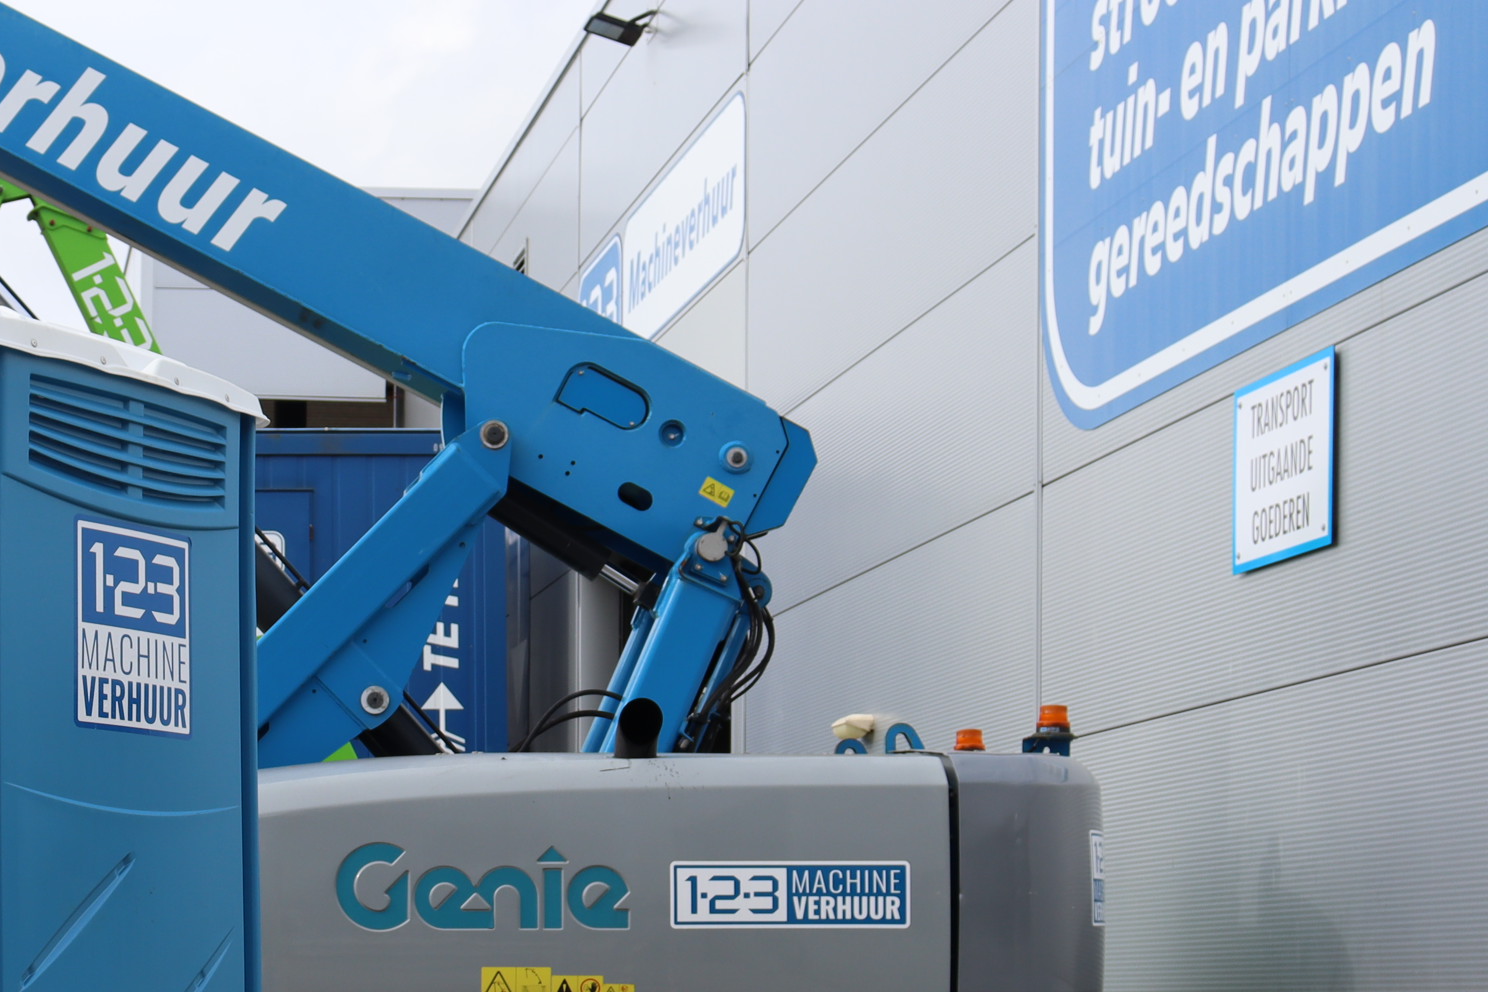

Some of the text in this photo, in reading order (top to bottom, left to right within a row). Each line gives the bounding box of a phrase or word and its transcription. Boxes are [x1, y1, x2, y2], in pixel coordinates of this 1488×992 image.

[1088, 61, 1171, 190] tuin-
[1179, 22, 1228, 121] en
[1088, 19, 1436, 335] gereedschappen
[627, 163, 737, 314] Machineverhuur
[1250, 379, 1314, 439] TRANSPORT
[1250, 435, 1314, 492] UITGAANDE
[1252, 492, 1310, 545] GOEDEREN
[81, 628, 188, 683] MACHINE
[81, 674, 188, 729] VERHUUR
[335, 841, 631, 932] Genie
[791, 869, 901, 894] MACHINE
[793, 896, 902, 921] VERHUUR
